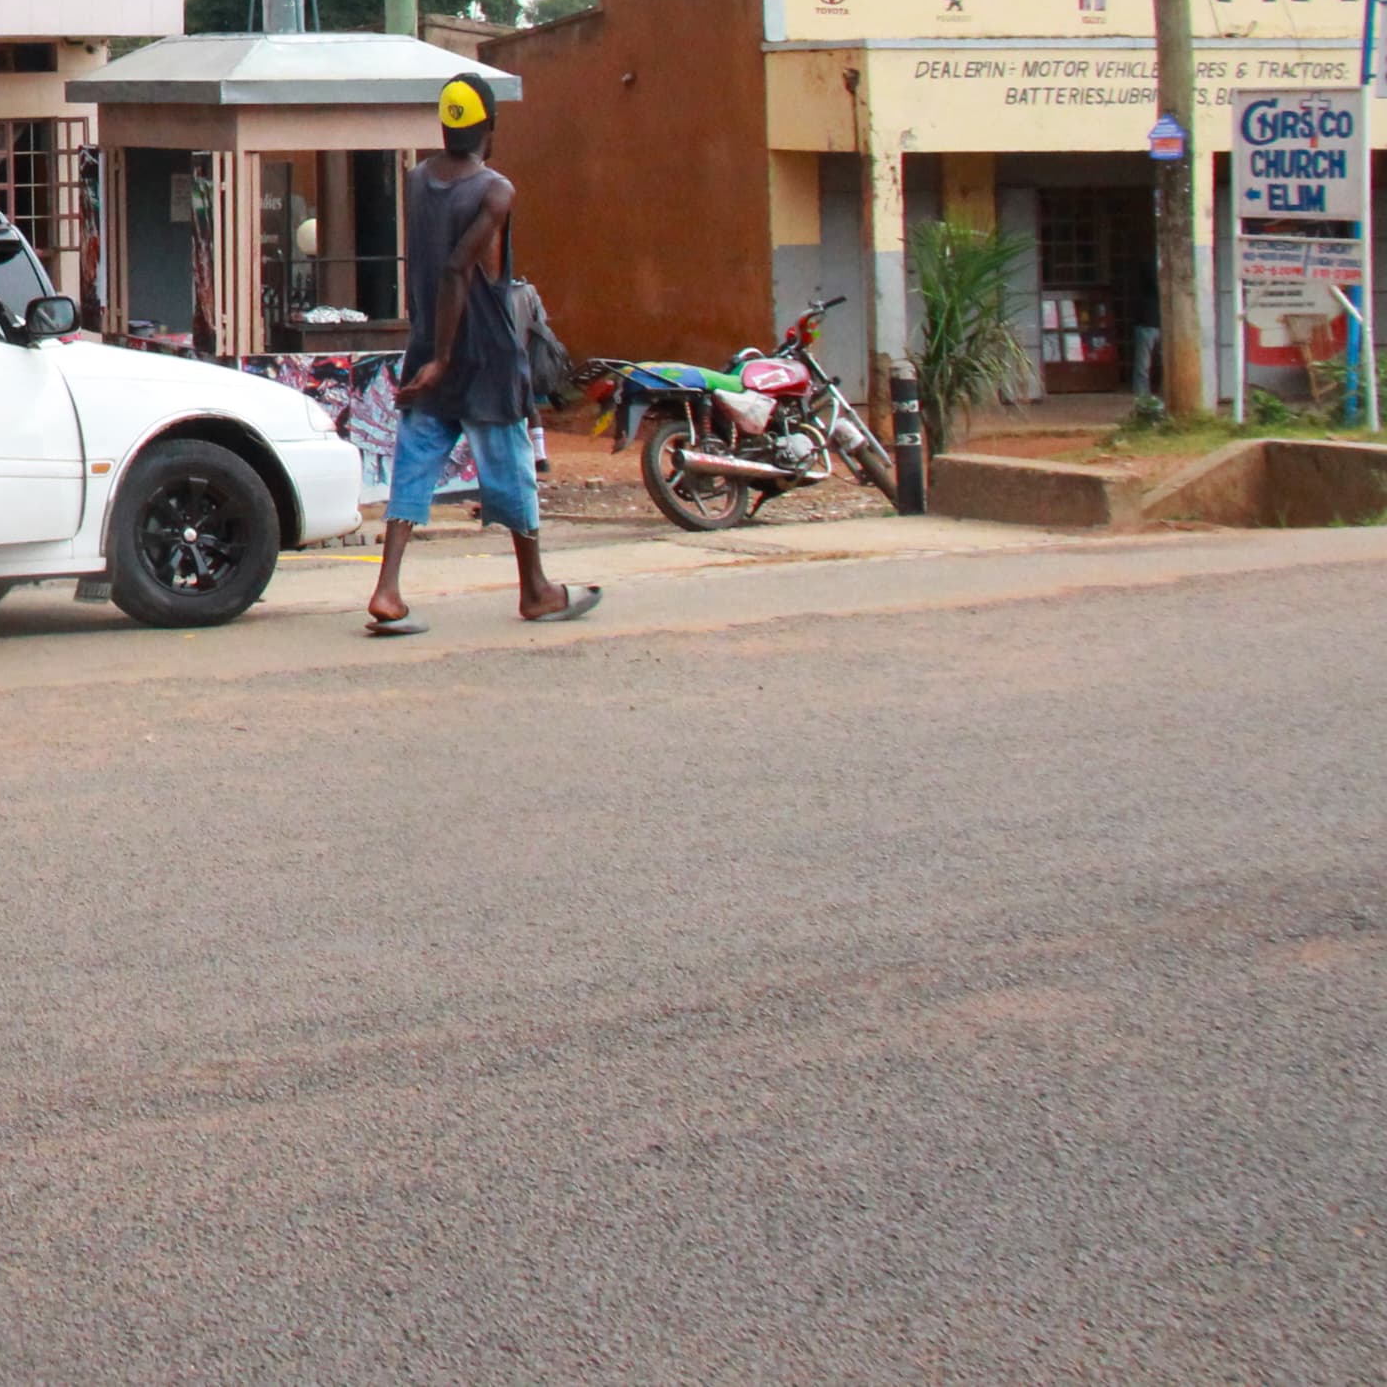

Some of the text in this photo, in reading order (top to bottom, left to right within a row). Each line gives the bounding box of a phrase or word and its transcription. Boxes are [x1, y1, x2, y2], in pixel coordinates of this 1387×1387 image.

[1021, 61, 1088, 78] MOTOR
[1251, 150, 1347, 178] CHURCH
[1268, 184, 1326, 212] ELIM
